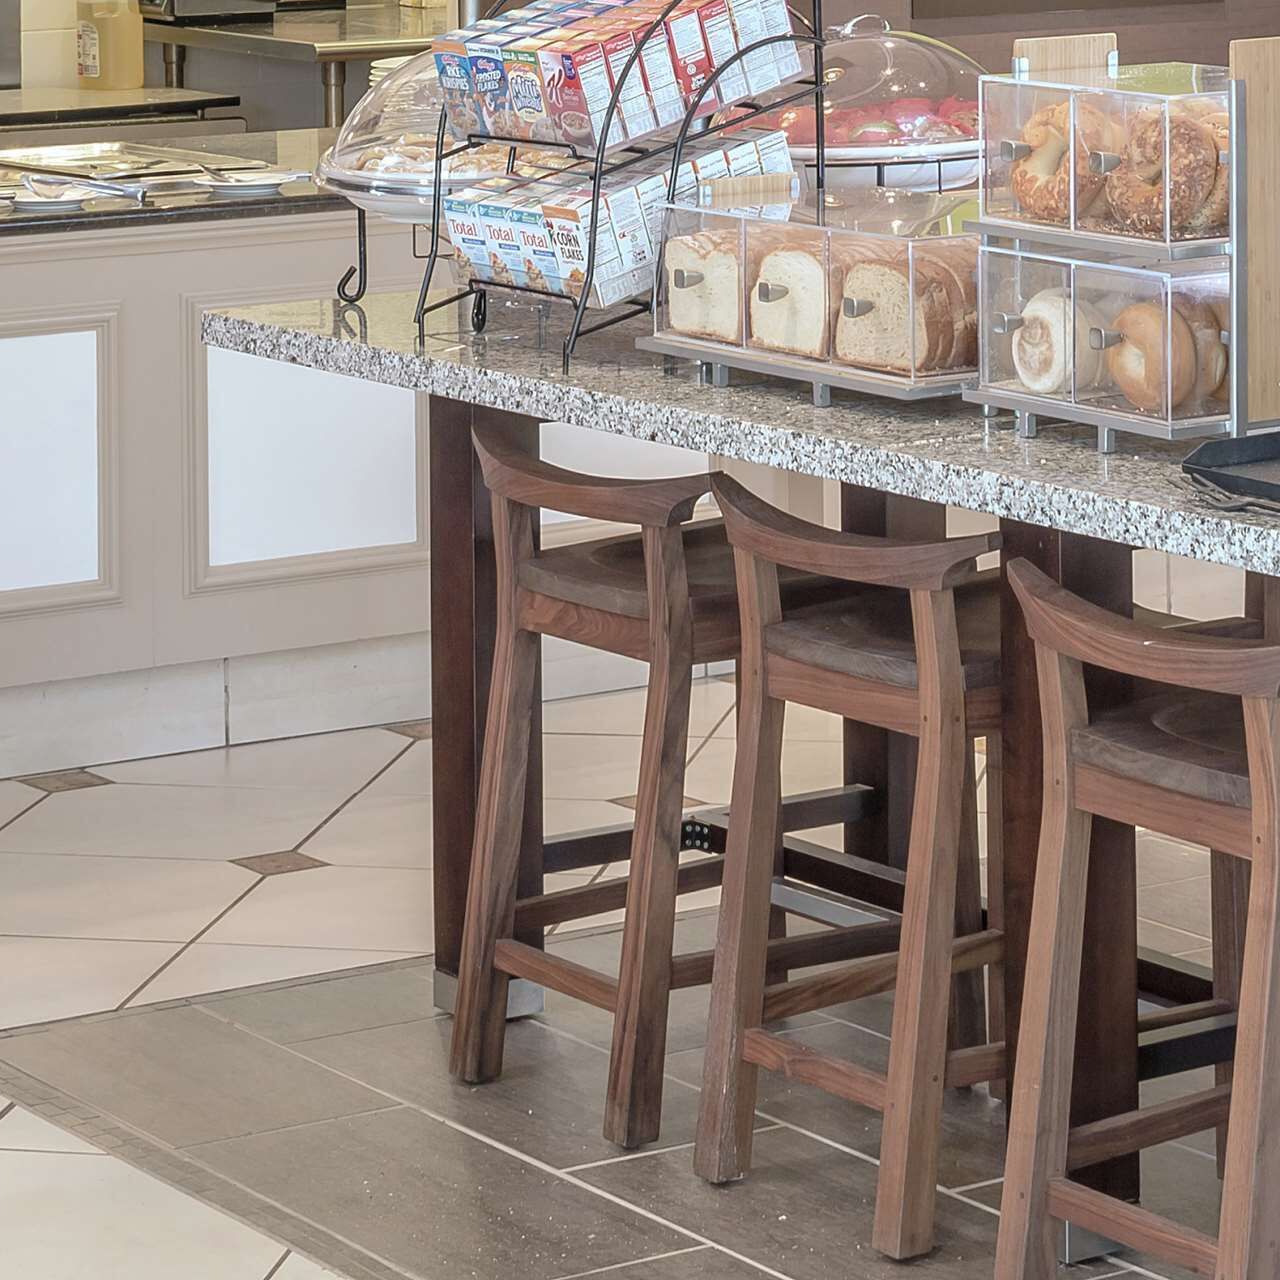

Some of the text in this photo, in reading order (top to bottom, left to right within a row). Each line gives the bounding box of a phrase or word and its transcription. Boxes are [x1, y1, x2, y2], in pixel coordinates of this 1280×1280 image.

[447, 65, 460, 78] RICE
[475, 70, 502, 83] FROSTED
[441, 76, 470, 91] KRISPIES
[477, 80, 500, 94] FLAKES
[449, 219, 478, 237] Total
[486, 224, 515, 242] Total
[520, 230, 549, 249] Total
[557, 231, 581, 248] CORN
[560, 246, 584, 262] FLAKES
